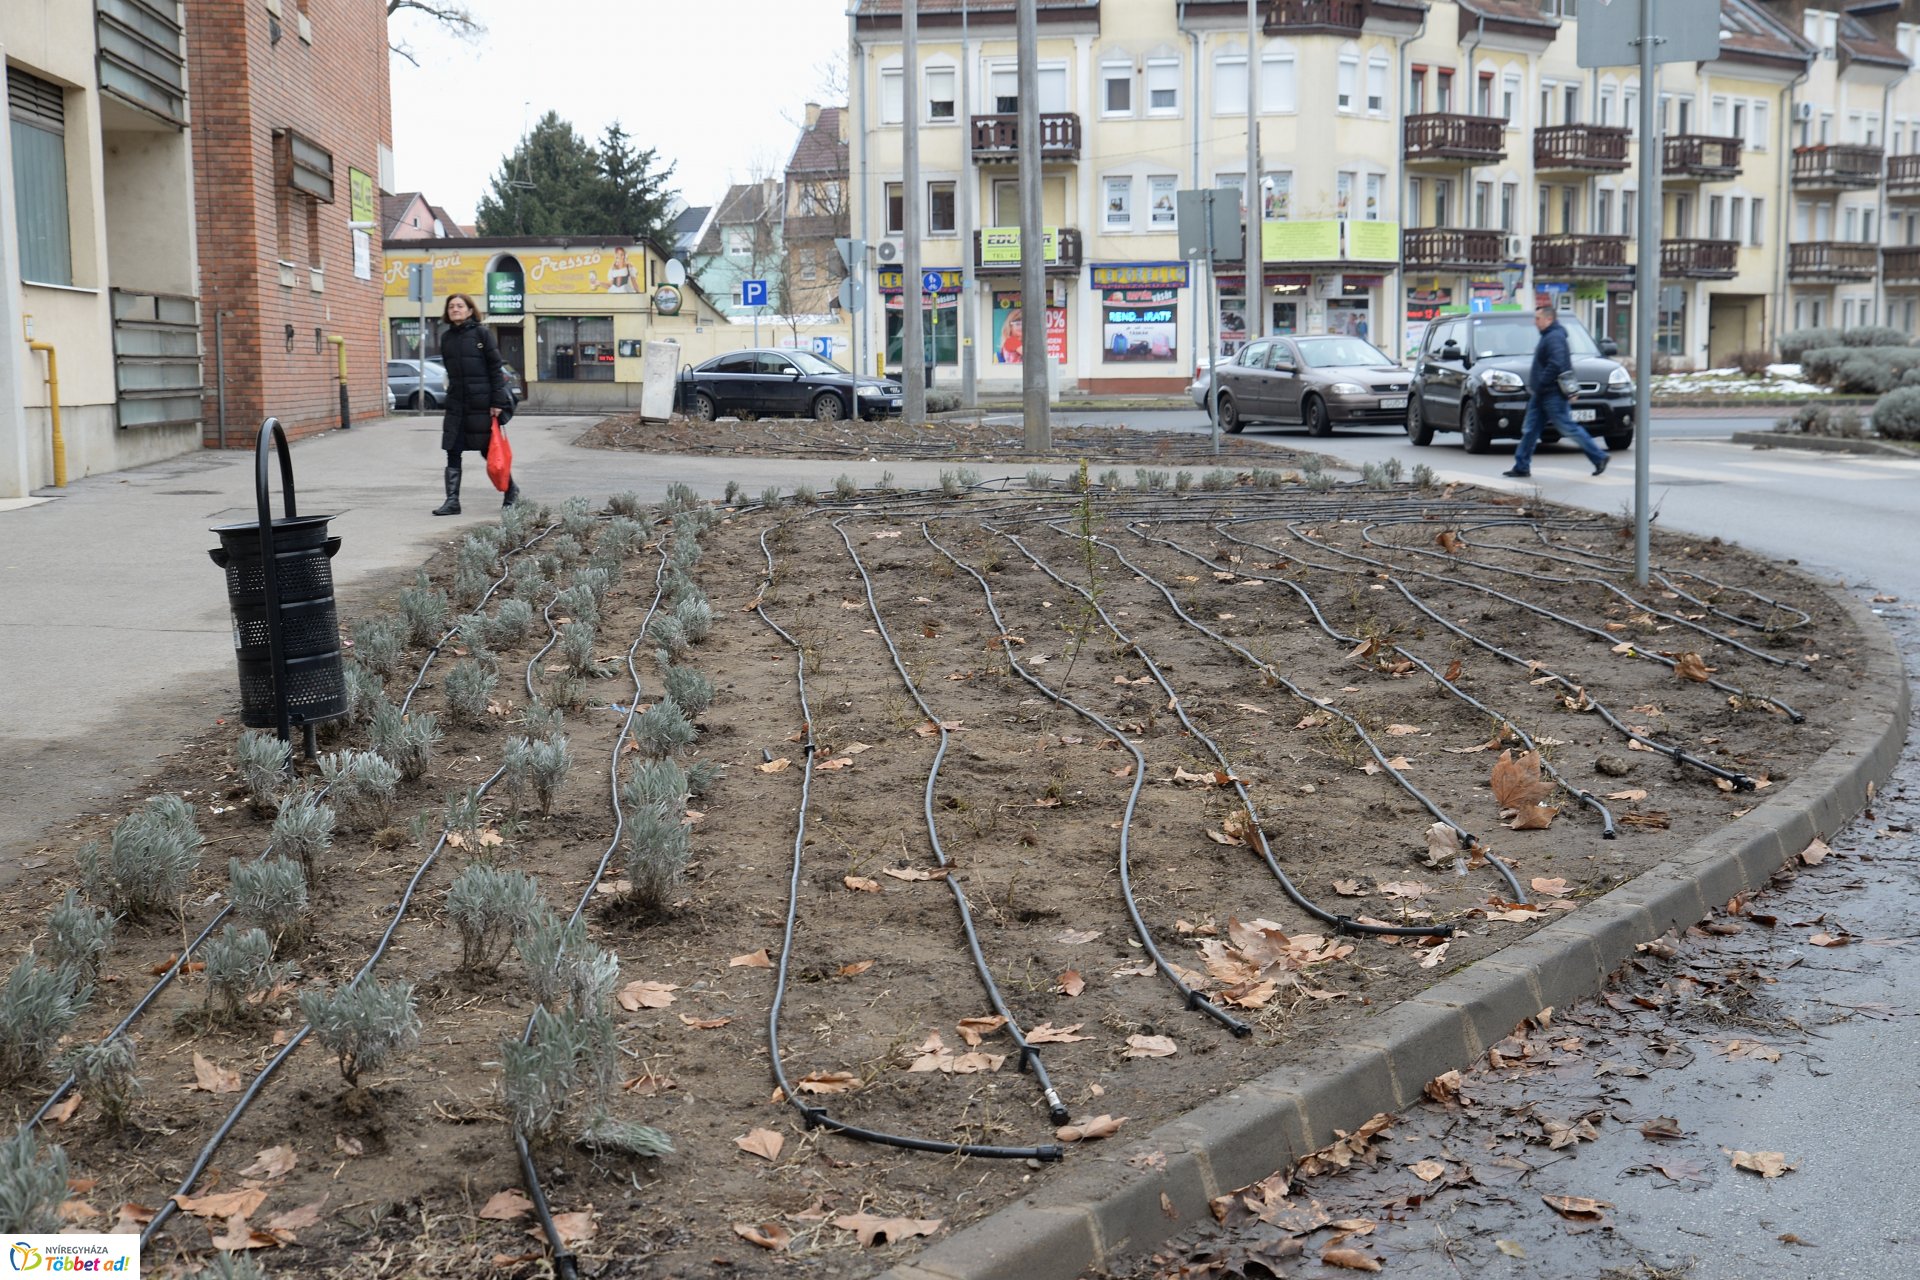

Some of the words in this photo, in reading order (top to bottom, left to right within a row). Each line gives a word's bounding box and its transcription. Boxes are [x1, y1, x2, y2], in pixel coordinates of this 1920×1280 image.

[1095, 267, 1185, 283] LEPORELLO
[748, 283, 762, 303] P
[1474, 299, 1486, 312] T
